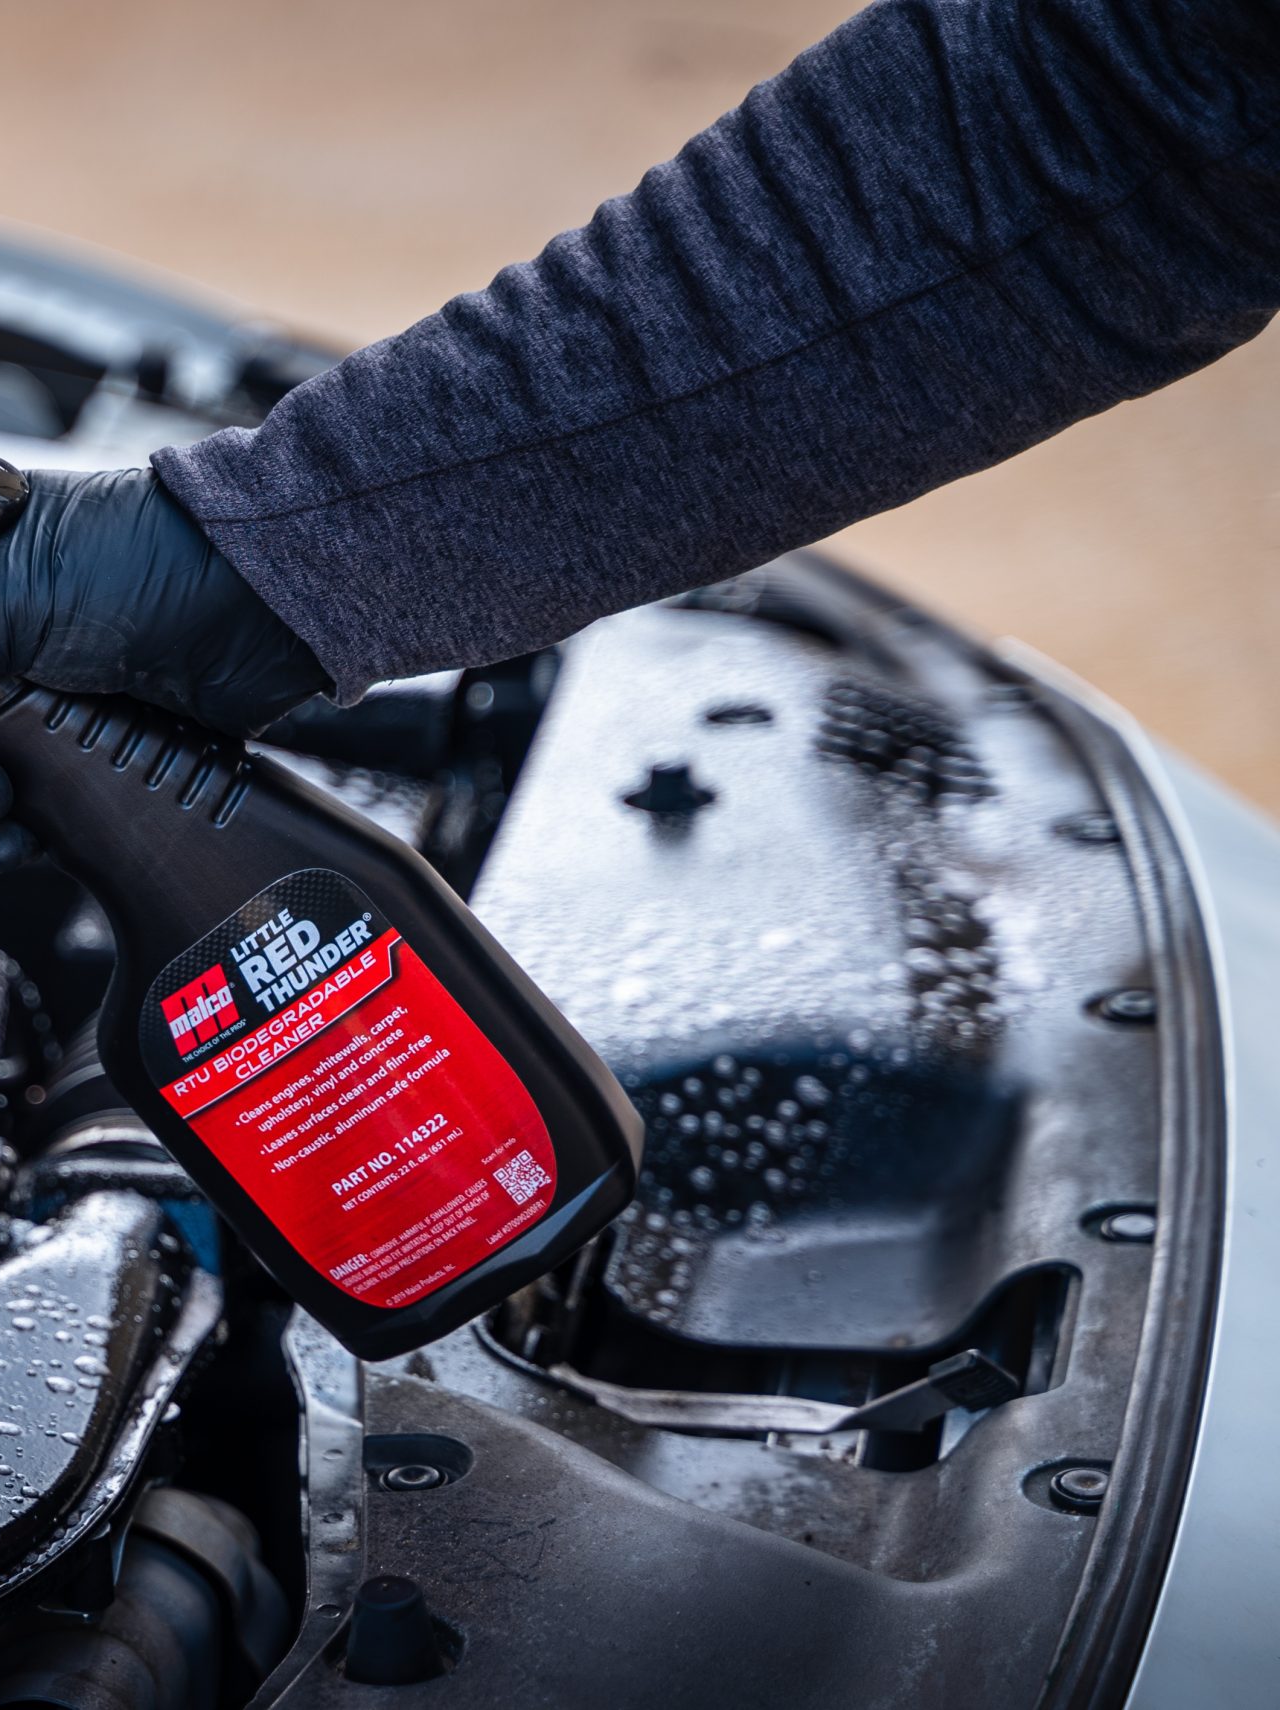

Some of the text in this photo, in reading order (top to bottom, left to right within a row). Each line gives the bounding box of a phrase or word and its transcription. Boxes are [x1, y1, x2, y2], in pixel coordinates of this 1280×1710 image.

[230, 907, 294, 962] LITTLE
[238, 919, 320, 993] RED
[173, 950, 376, 1096] RTU BIODEGRADABLE
[182, 1053, 194, 1063] THE
[192, 1041, 213, 1057] CHOICE
[211, 1036, 220, 1045] OF
[219, 1029, 232, 1039] THE
[235, 1012, 325, 1079] CLEANER
[238, 1006, 408, 1123] Cleans engines, whitewalls, carpet,
[257, 1028, 404, 1132] upholstery, vinyl and concrete
[262, 1034, 432, 1153] Leaves surfaces clean and film-free
[273, 1048, 450, 1171] Non-caustic, aluminum safe formula
[331, 1113, 448, 1196] PART NO. 114322
[341, 1127, 463, 1211] NET CONTENTS: 22 fl. oz. (651 mL)
[481, 1152, 497, 1165] Scan
[494, 1145, 504, 1155] for
[329, 1253, 372, 1280] DANGER:
[398, 1221, 427, 1241] HARMFUL
[423, 1216, 431, 1225] IF
[429, 1194, 467, 1222] SWALLOWED.
[464, 1178, 487, 1197] CAUSES
[390, 1248, 403, 1260] EYE
[429, 1221, 444, 1235] KEEP
[443, 1213, 457, 1226] OUT
[454, 1208, 464, 1218] OF
[462, 1196, 483, 1213] REACH
[480, 1189, 490, 1200] OF
[398, 1241, 436, 1267] PRECAUTIONS
[433, 1237, 444, 1246] ON
[441, 1226, 458, 1241] BACK
[455, 1216, 477, 1231] PANEL.
[485, 1229, 504, 1245] Label
